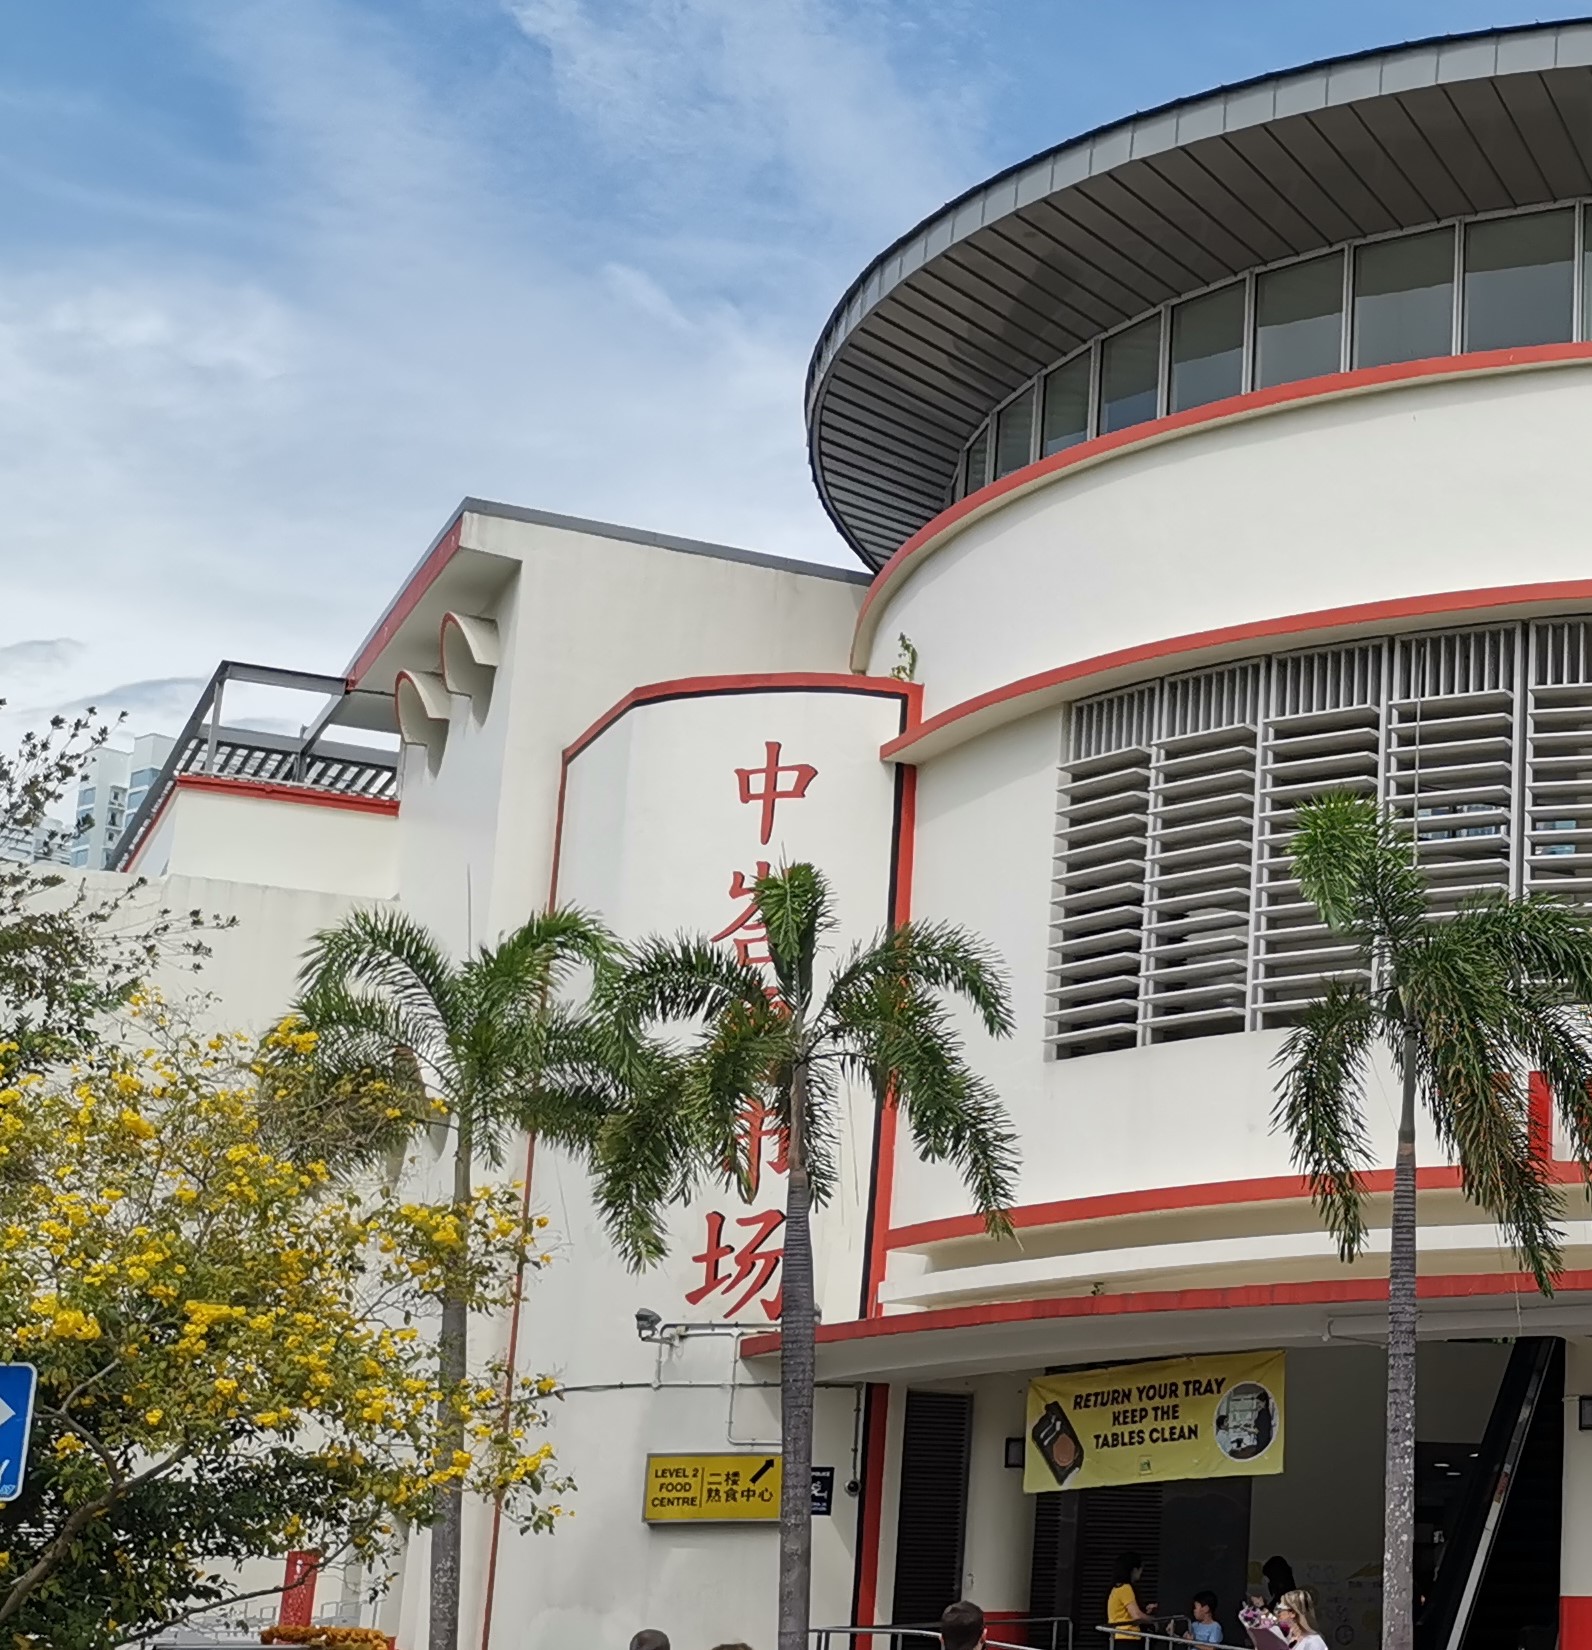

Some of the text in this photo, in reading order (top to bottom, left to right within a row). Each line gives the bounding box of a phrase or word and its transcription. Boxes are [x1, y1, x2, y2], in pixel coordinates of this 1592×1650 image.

[1073, 1377, 1227, 1411] RETURN YOUR TRAY
[1112, 1404, 1180, 1427] KEEP THE
[1094, 1424, 1198, 1449] TABLES CLEAN
[655, 1467, 699, 1479] LEVEL 2
[659, 1482, 692, 1493] FOOD
[651, 1496, 697, 1508] CENTRE
